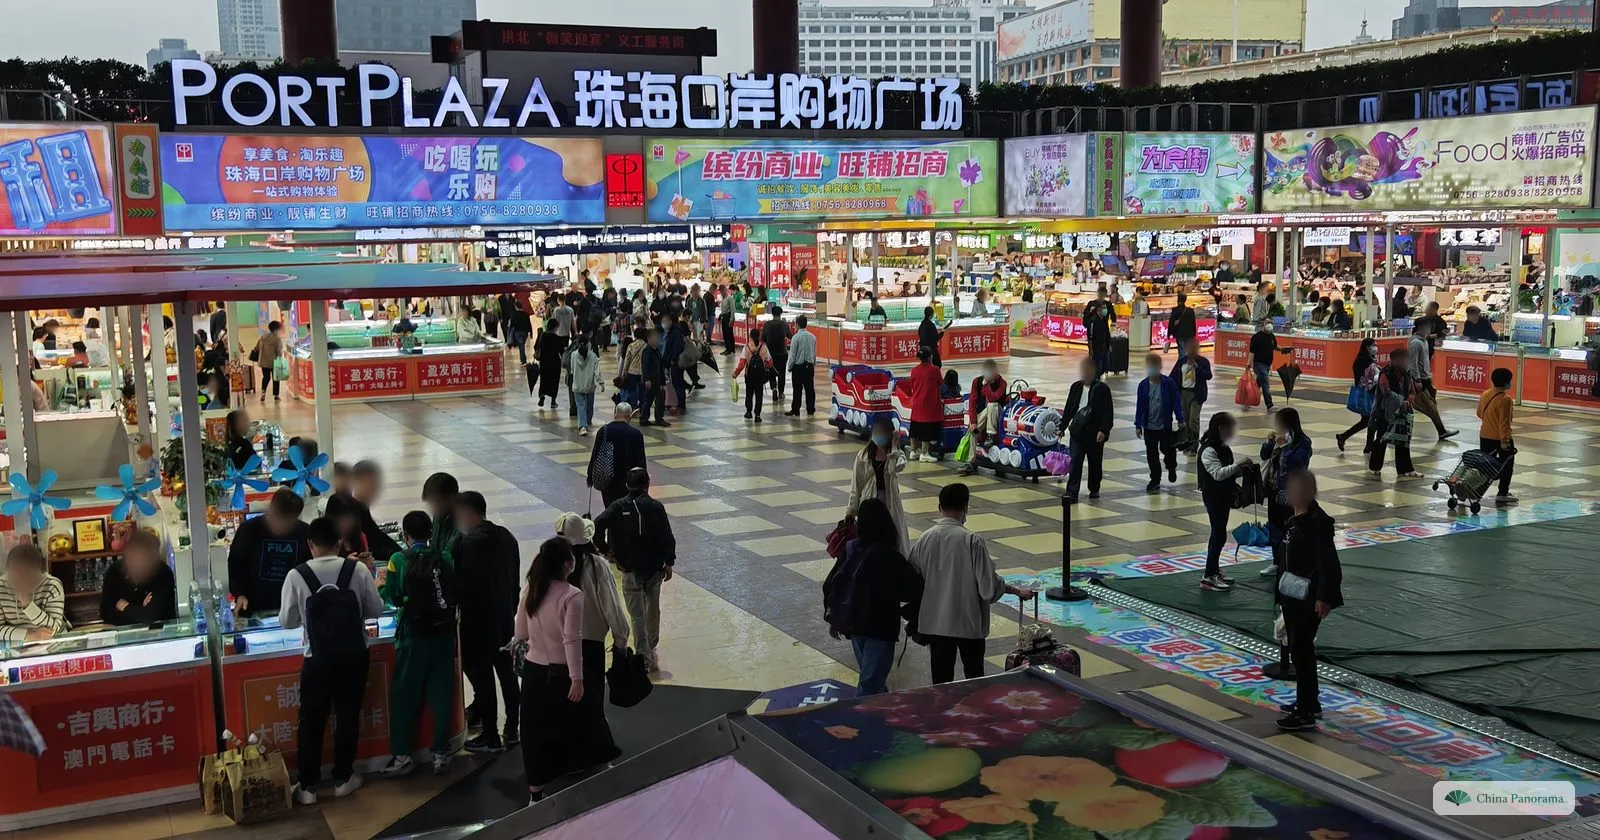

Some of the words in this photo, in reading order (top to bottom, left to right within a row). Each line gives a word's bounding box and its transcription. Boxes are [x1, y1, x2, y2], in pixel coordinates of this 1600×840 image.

[170, 59, 345, 127] PORT
[358, 64, 561, 128] PLAZA
[574, 70, 963, 131] 珠海口岸购物广场
[1511, 129, 1585, 147] 商铺/广告位
[243, 147, 345, 162] 享美食·淘乐趣
[424, 144, 499, 173] 吃喝玩
[1140, 145, 1210, 174] 为食街
[1436, 136, 1508, 164] Food
[1511, 143, 1586, 162] 火爆招商中
[225, 165, 365, 183] 珠海口岸购物广场
[701, 150, 823, 181] 缤纷商业
[837, 149, 949, 178] 旺铺招商
[253, 185, 339, 198] 一站式购物体验
[447, 172, 498, 200] 乐购
[1534, 174, 1583, 187] 招商热线
[1559, 386, 1593, 396] 澳門電話
[267, 543, 294, 553] FILA
[63, 734, 176, 771] 澳門電話卡
